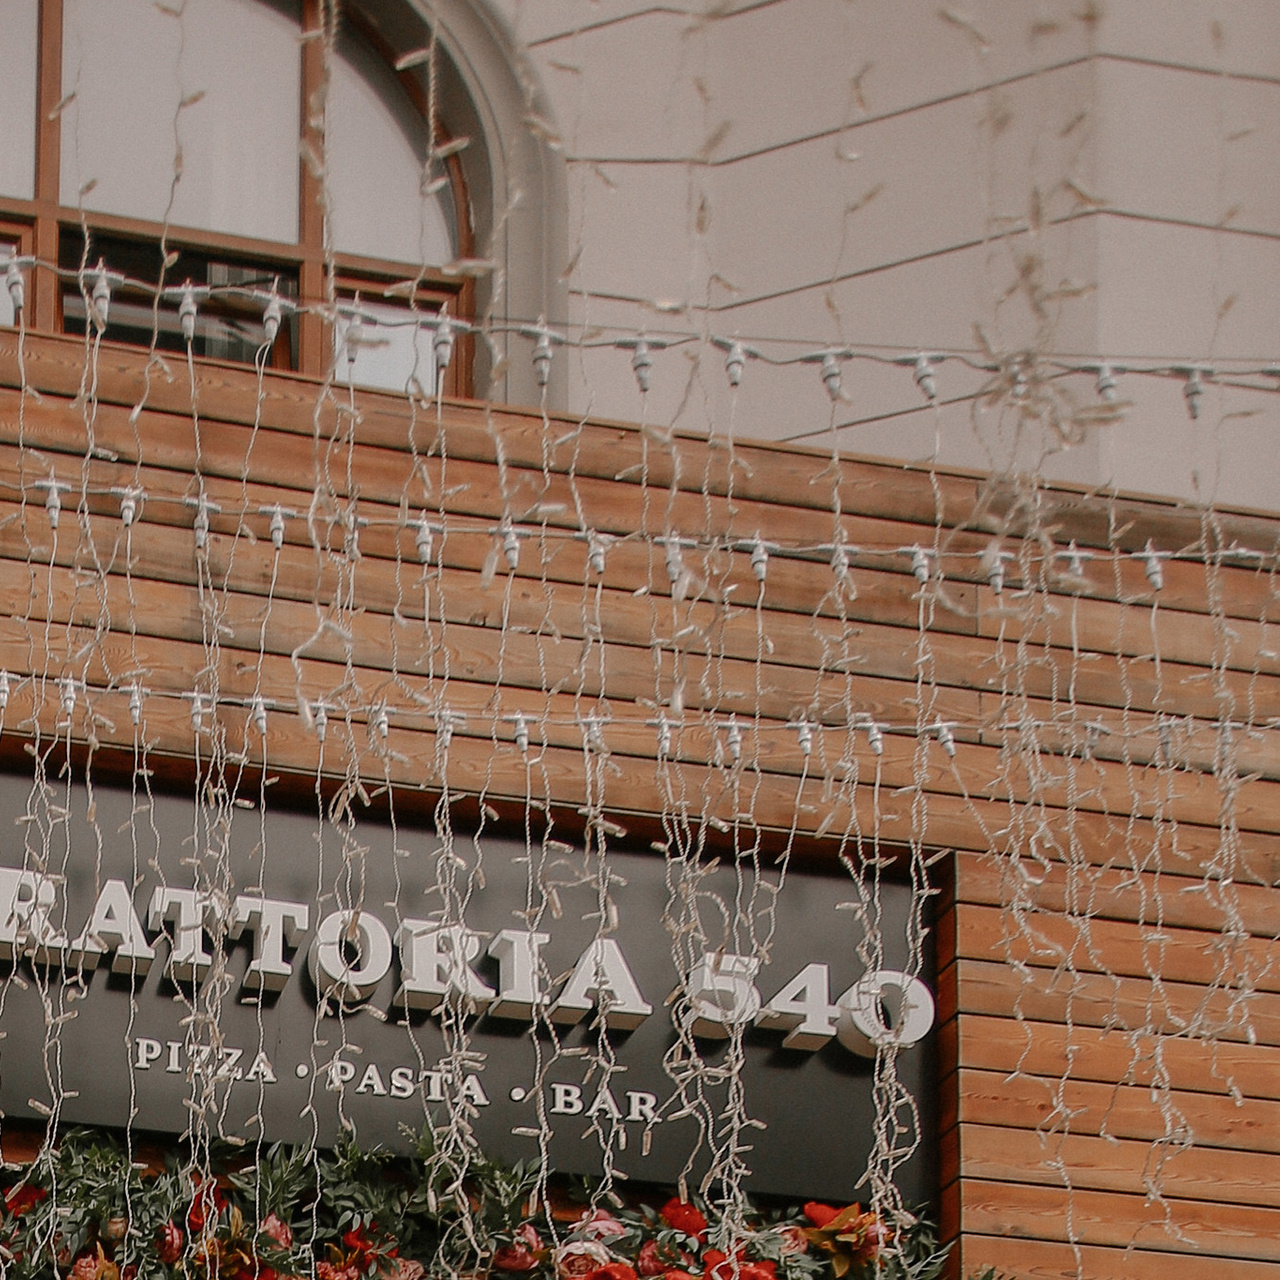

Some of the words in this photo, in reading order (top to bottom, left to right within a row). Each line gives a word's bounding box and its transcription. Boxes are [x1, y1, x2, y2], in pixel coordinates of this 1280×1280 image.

[685, 951, 936, 1056] 540
[134, 1037, 278, 1083] PIZZA
[326, 1060, 490, 1106] PASTA
[550, 1082, 663, 1123] BAR
